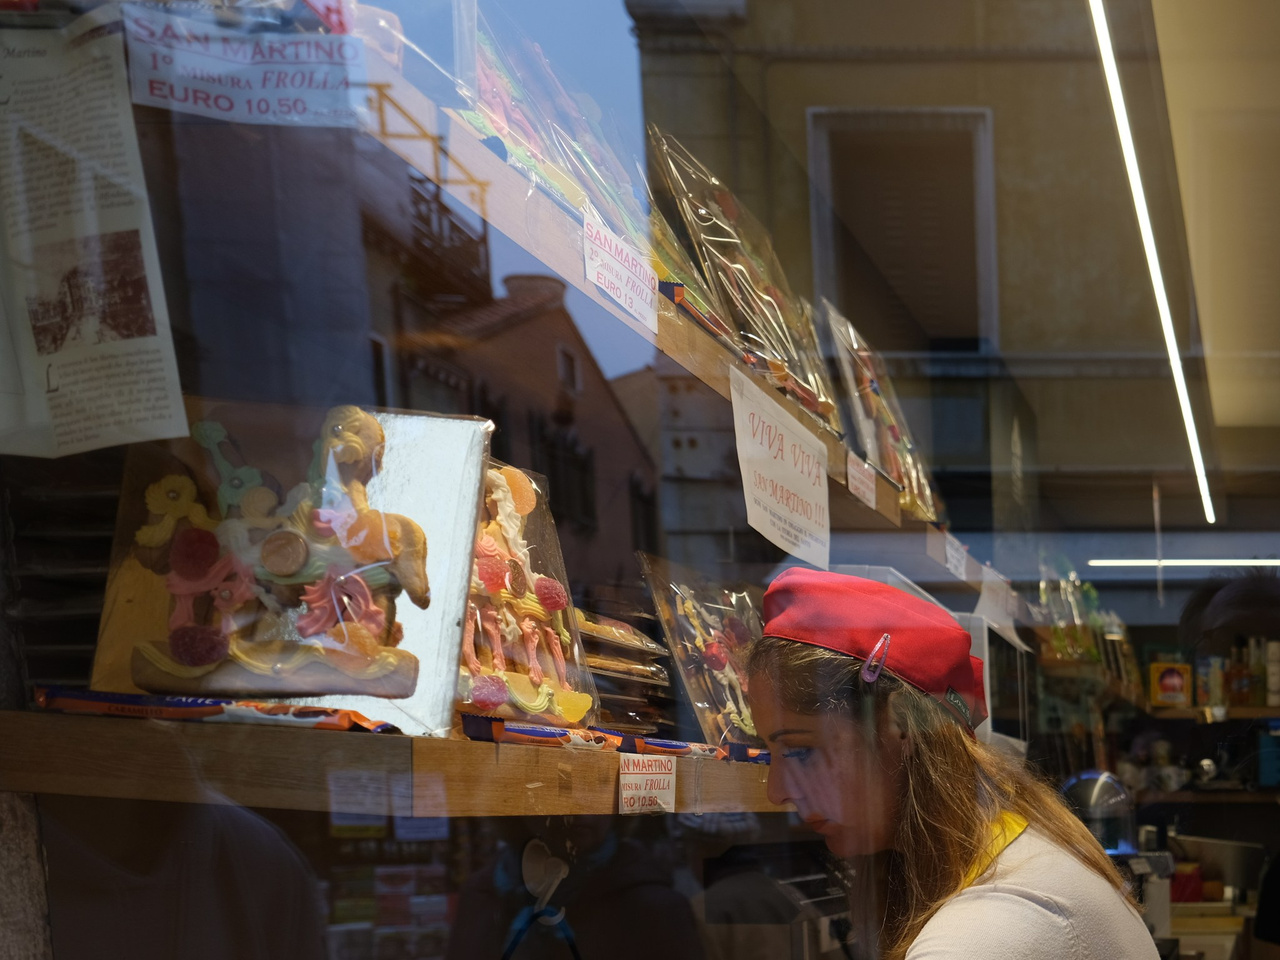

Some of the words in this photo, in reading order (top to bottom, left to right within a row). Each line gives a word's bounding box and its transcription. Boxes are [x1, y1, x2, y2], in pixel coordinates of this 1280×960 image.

[133, 16, 210, 50] SAN
[221, 38, 359, 62] MARTINO
[149, 80, 234, 112] EURO
[261, 70, 351, 90] FROLLA
[586, 222, 612, 252] SAN
[614, 244, 656, 290] MARTINO
[597, 272, 621, 298] EURO
[624, 294, 633, 309] 13
[601, 260, 622, 282] MISURA
[625, 275, 653, 309] FROLLA
[749, 412, 784, 461] VIVA
[791, 443, 822, 487] VIVA
[753, 470, 769, 492] SAN
[769, 479, 812, 520] MARTINO
[633, 759, 672, 771] MARTINO
[624, 797, 635, 807] RO
[644, 779, 670, 790] FROLLA
